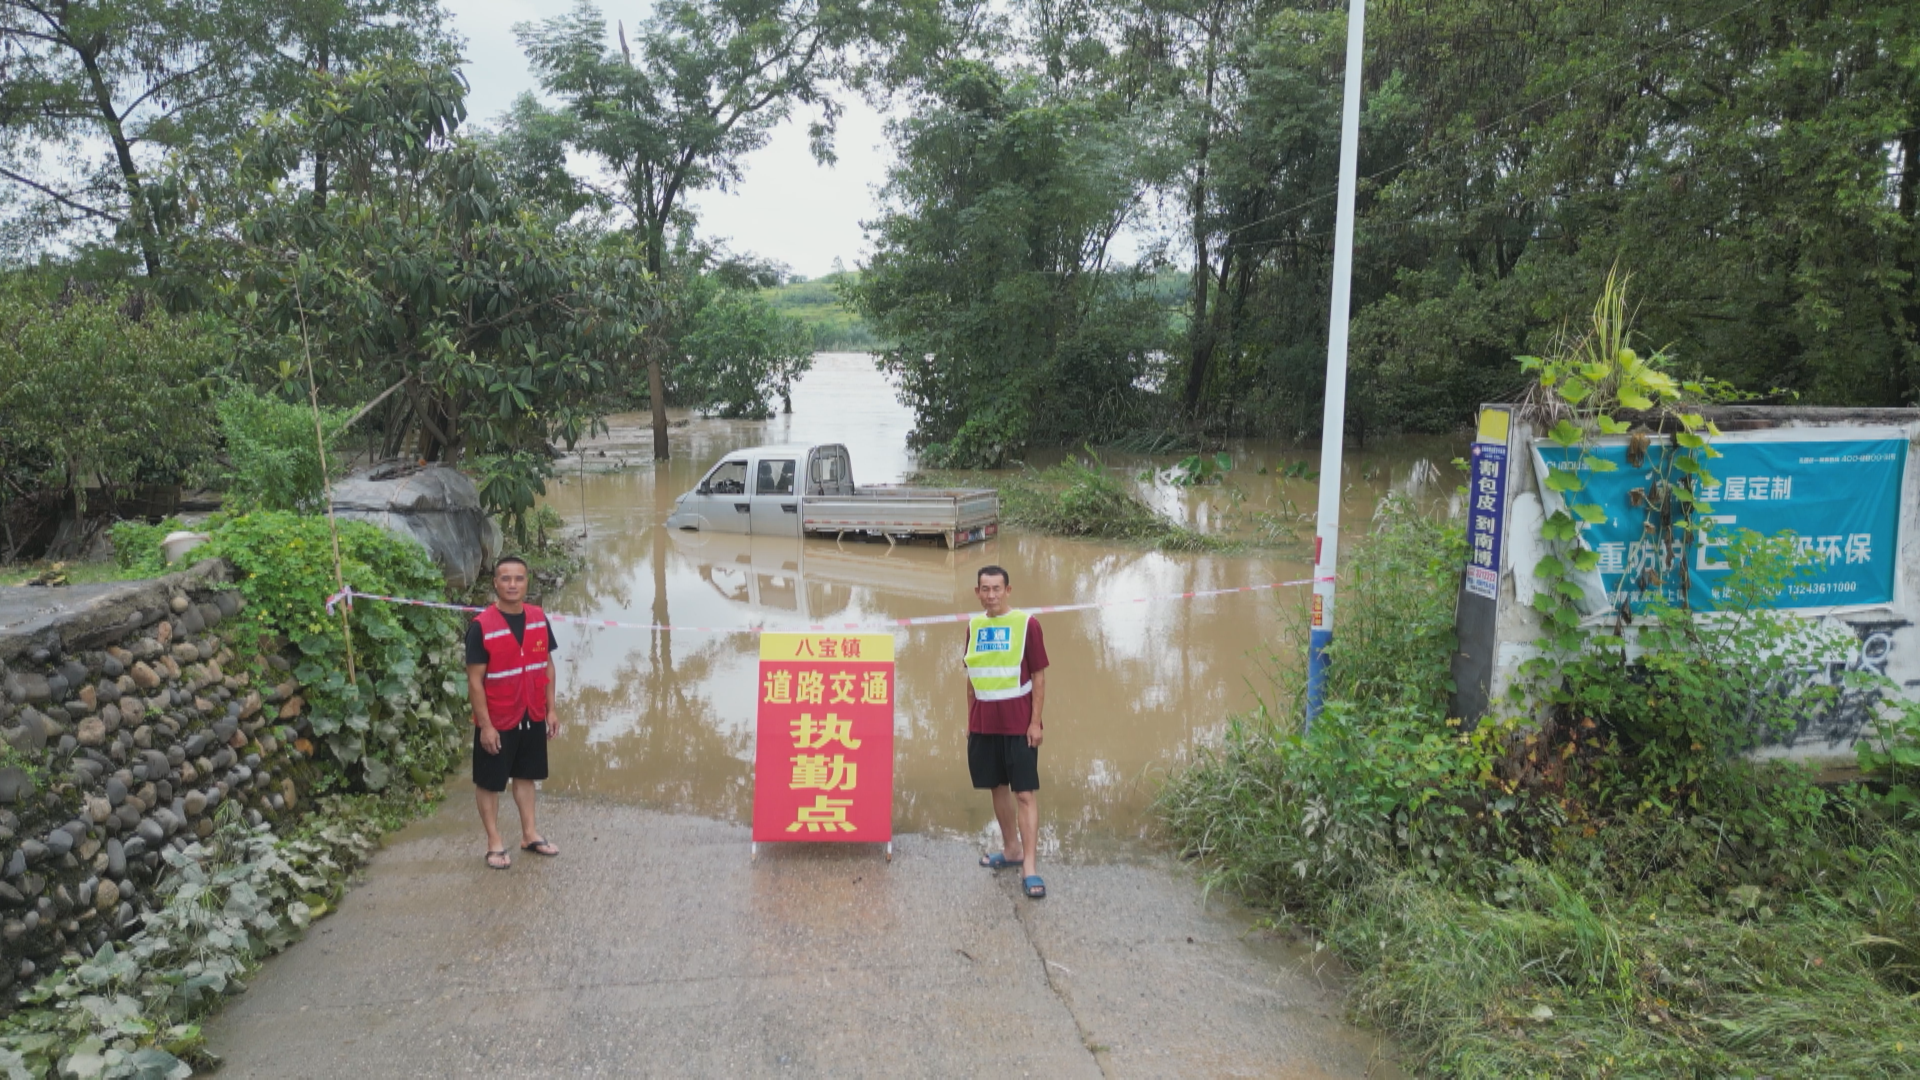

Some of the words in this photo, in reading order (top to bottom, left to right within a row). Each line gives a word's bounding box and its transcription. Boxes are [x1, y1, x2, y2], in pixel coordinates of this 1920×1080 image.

[1476, 459, 1499, 512] 割包皮
[1473, 515, 1495, 568] 到南博
[1787, 581, 1857, 595] 13243611000
[795, 637, 862, 659] 八宝镇
[763, 669, 889, 705] 道路交通
[785, 712, 862, 833] 执勤点
